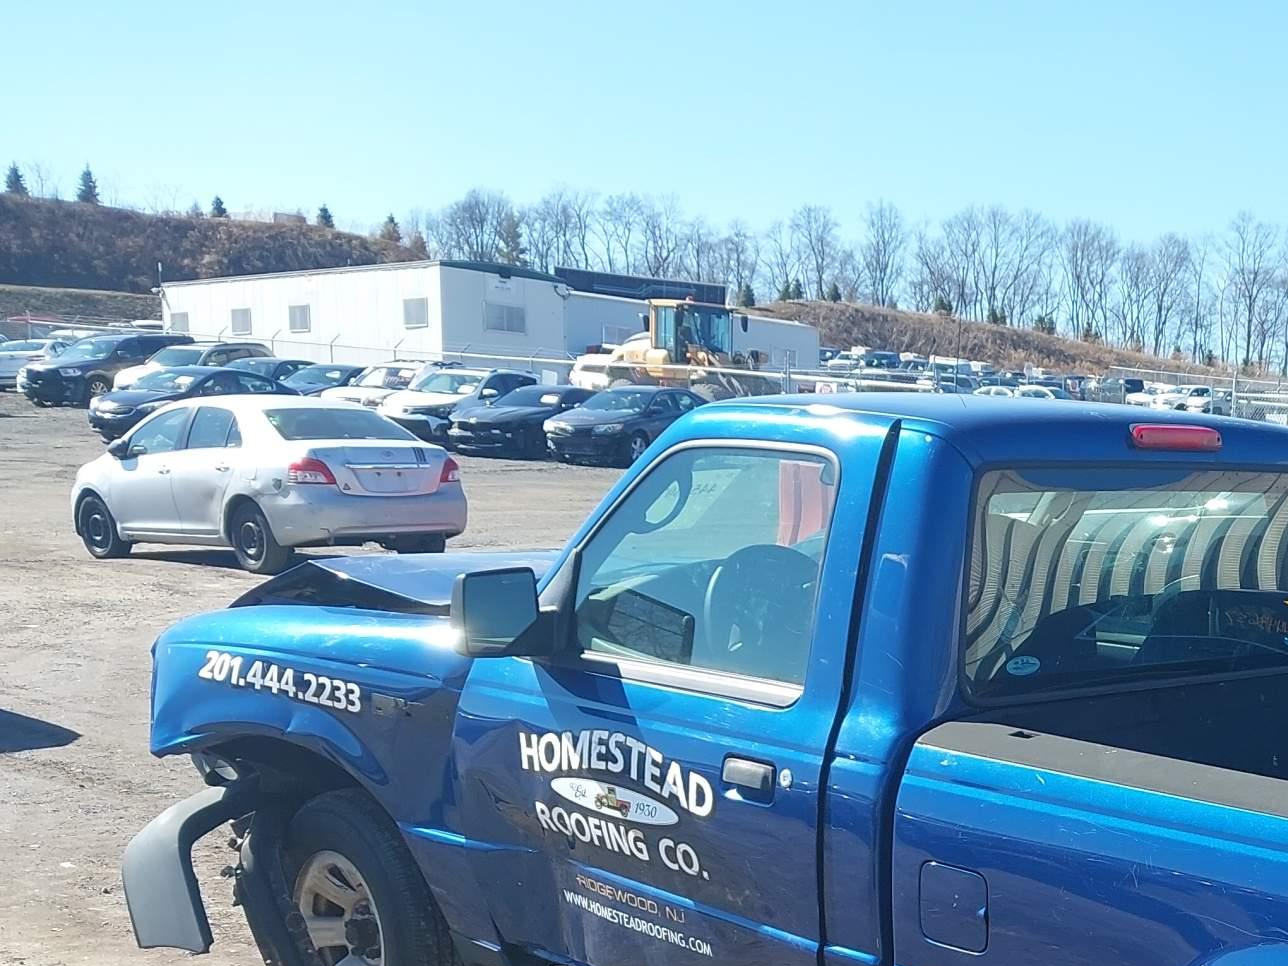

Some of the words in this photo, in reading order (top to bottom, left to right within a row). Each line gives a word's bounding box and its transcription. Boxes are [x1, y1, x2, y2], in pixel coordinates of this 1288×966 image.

[198, 651, 361, 712] 201.444.2233
[519, 730, 714, 817] HOMESTEAD
[535, 801, 649, 861] ROOFING
[658, 838, 710, 881] CO.
[563, 889, 713, 958] WWW.HOMESTEADROOFING.COM
[665, 905, 685, 924] NJ
